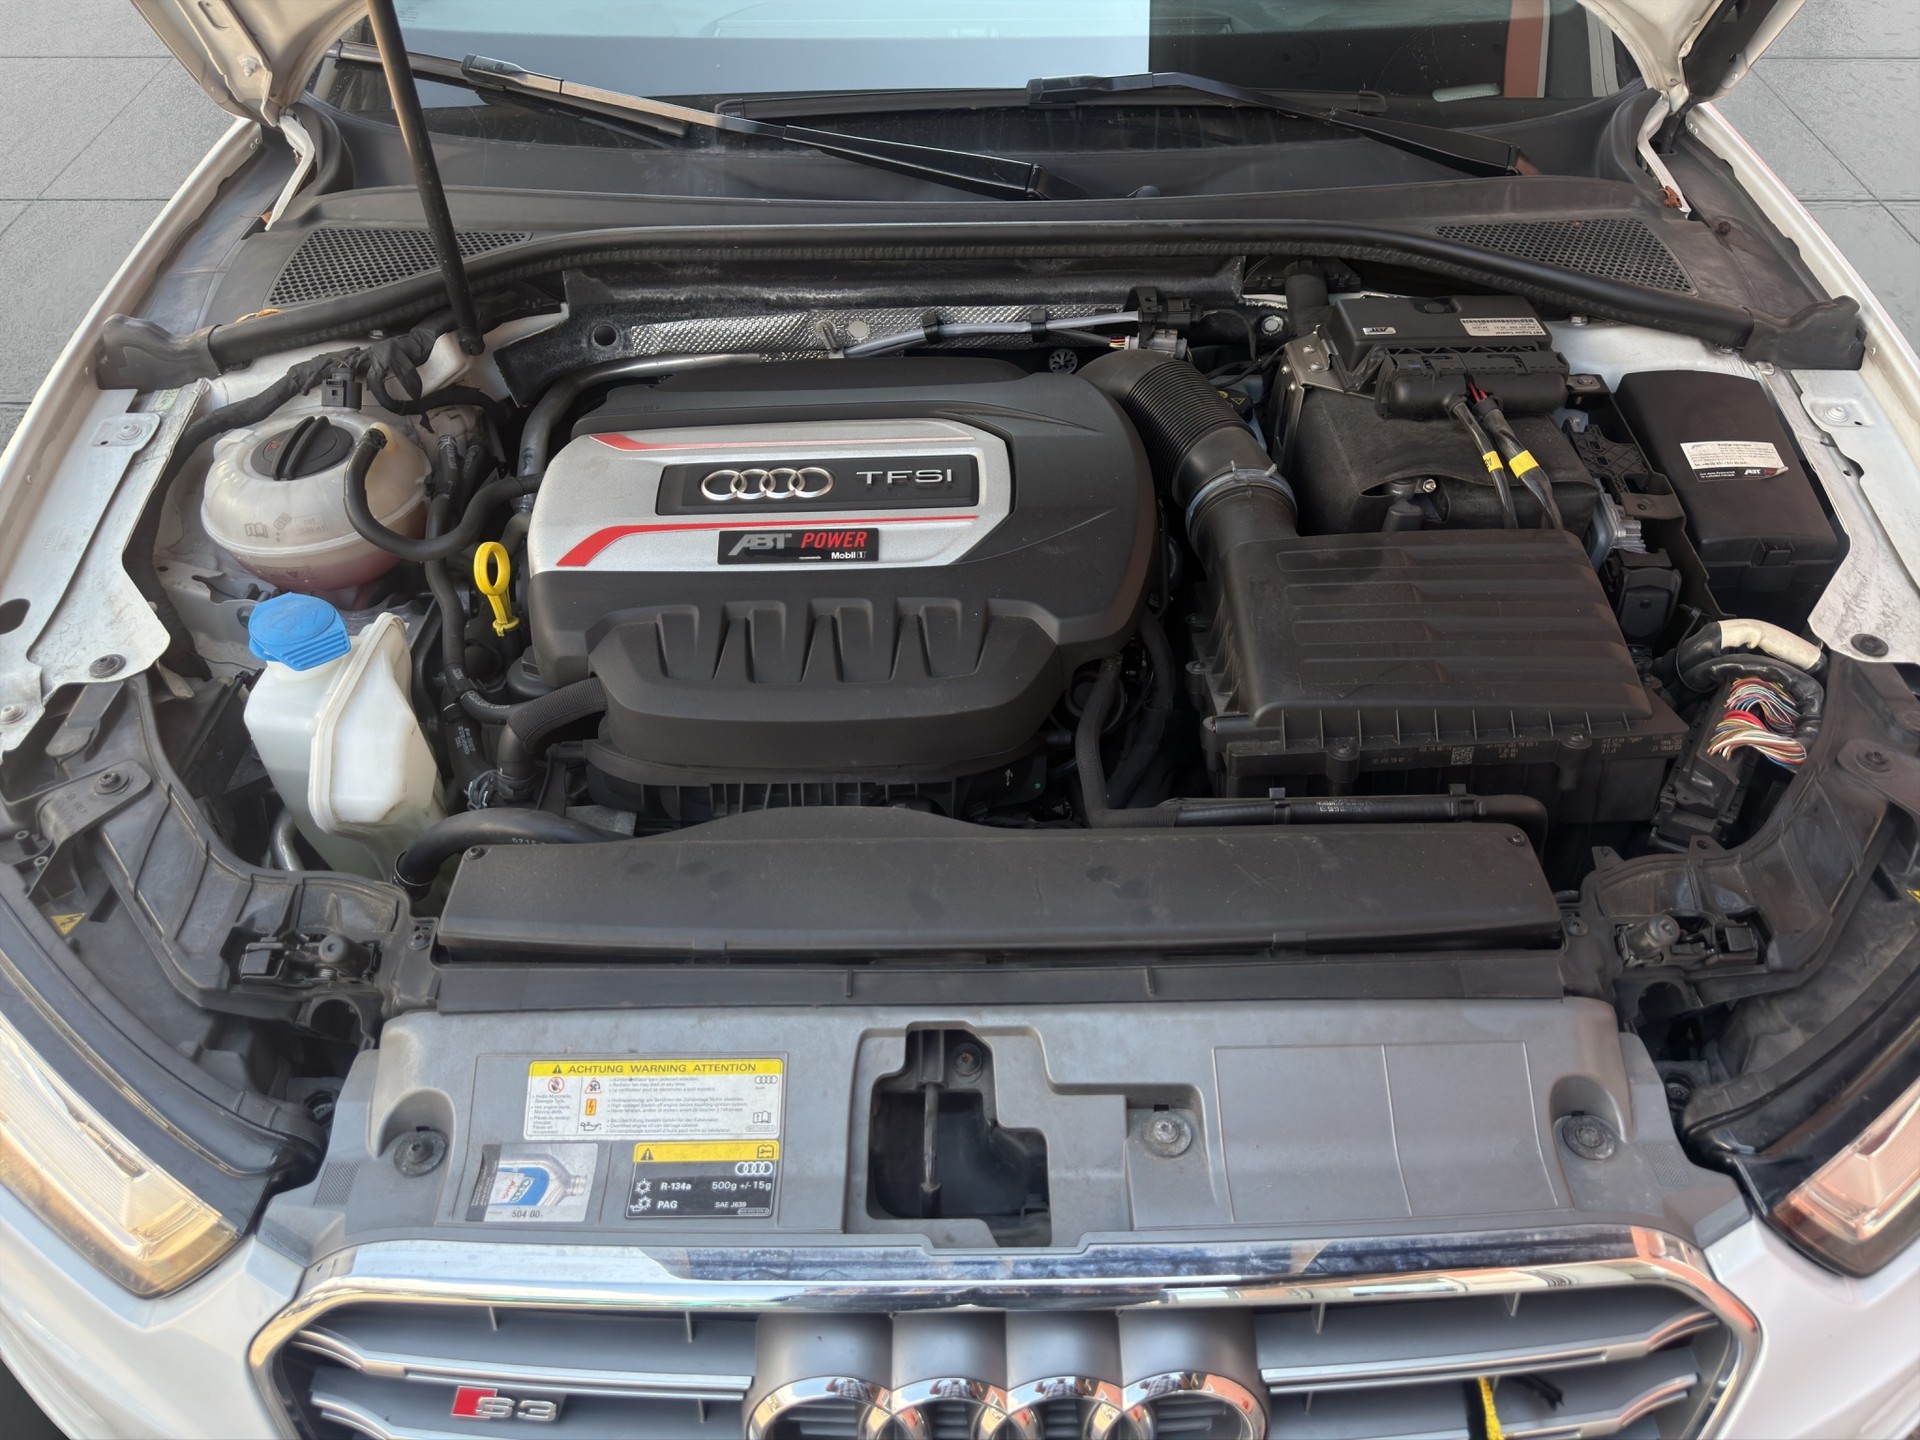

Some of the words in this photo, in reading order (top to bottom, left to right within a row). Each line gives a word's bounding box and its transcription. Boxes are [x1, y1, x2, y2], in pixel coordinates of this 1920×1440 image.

[856, 468, 953, 485] TFSI
[728, 533, 793, 556] ABT
[801, 531, 868, 549] POWER
[831, 551, 856, 560] Mobil
[568, 1064, 624, 1074] ACHTUNG
[630, 1063, 687, 1073] WARNING
[693, 1062, 756, 1072] ATTENTION
[660, 1181, 692, 1191] R-134a
[711, 1181, 737, 1192] 500g
[753, 1181, 772, 1191] 15g
[657, 1200, 678, 1209] PAG
[715, 1201, 729, 1209] SAE
[512, 1209, 527, 1218] 504
[529, 1209, 541, 1218] 00
[476, 1396, 557, 1422] S3
